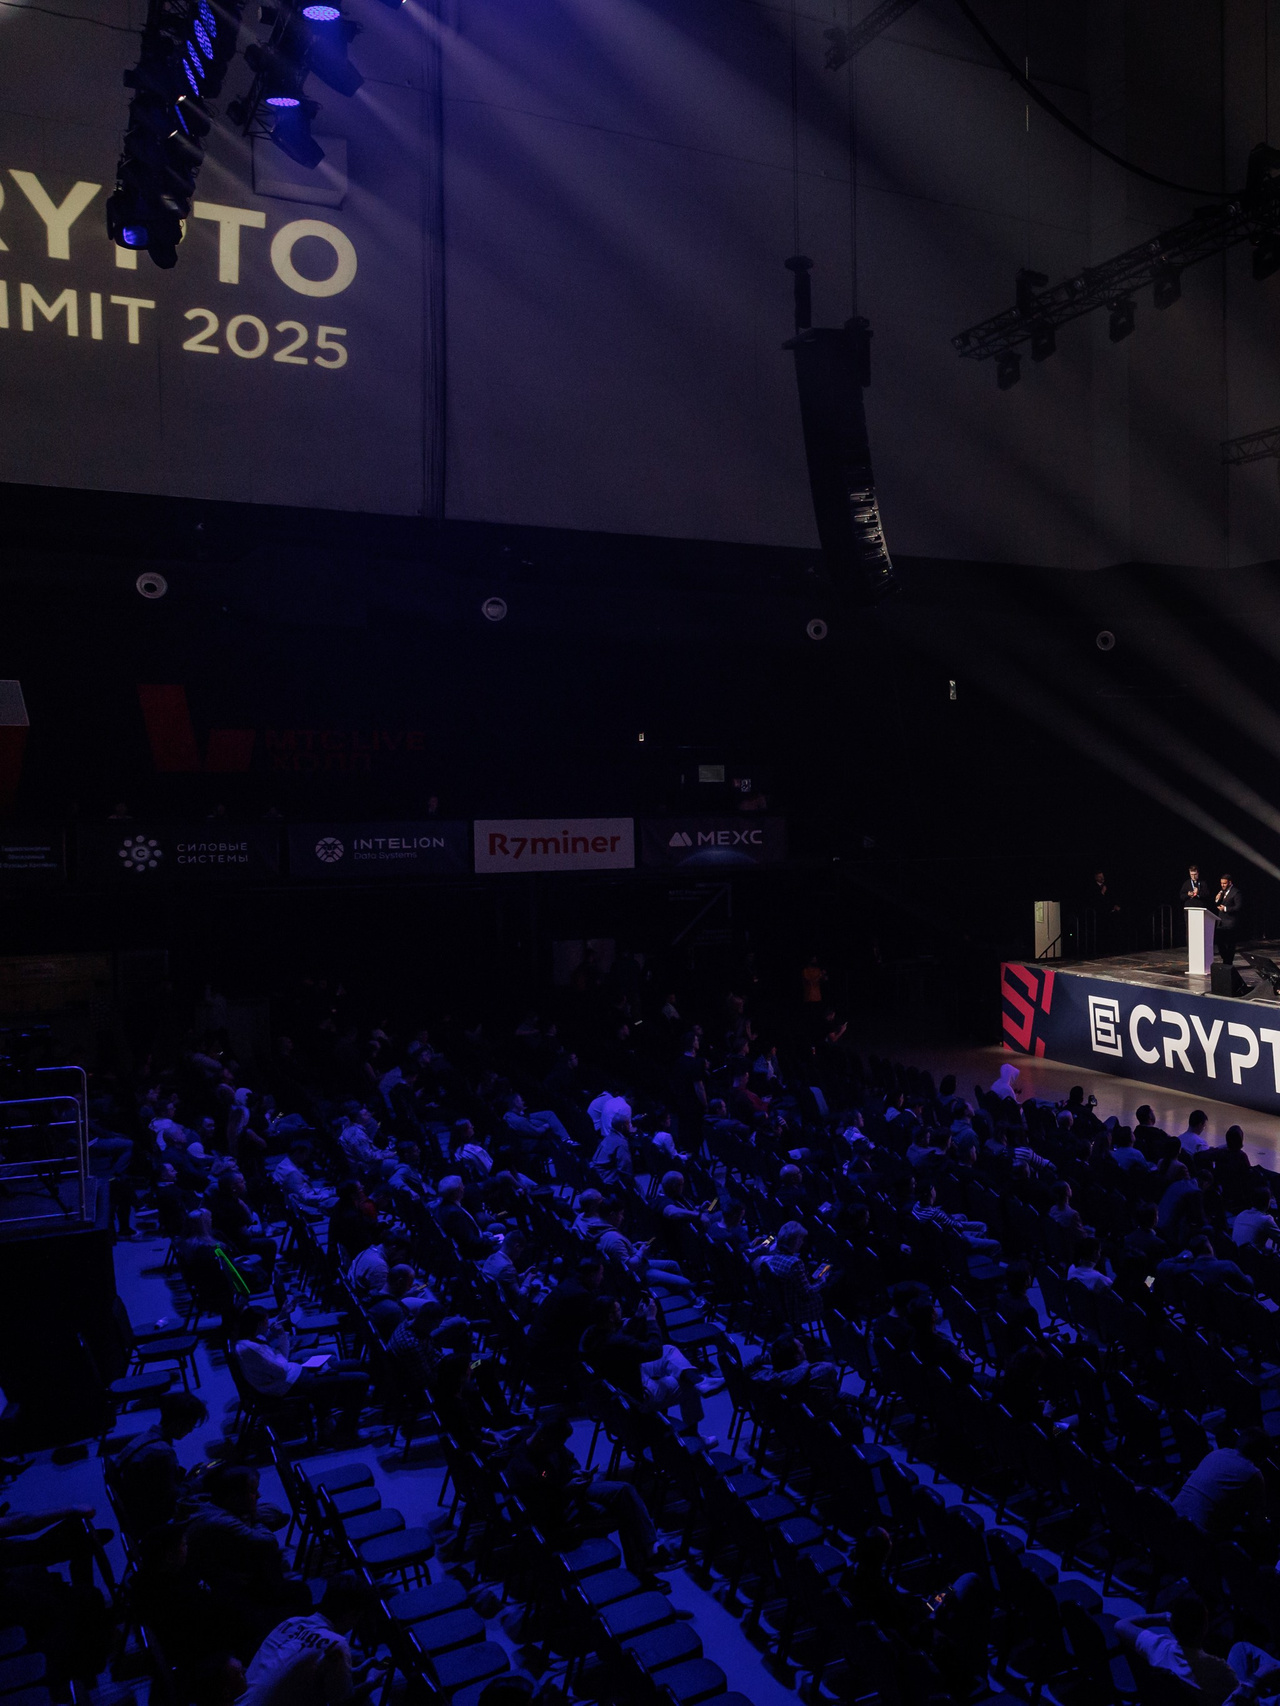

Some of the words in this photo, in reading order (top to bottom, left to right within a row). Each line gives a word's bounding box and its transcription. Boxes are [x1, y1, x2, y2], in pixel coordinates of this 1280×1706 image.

[182, 308, 347, 369] 2025
[354, 837, 445, 850] INTELION
[489, 830, 620, 859] R7miner
[697, 830, 763, 846] MEXC
[177, 842, 248, 852] СИЛОВЫЕ
[177, 854, 249, 864] СИСТЕМЫ
[354, 851, 376, 860] Data
[378, 851, 418, 861] Systems
